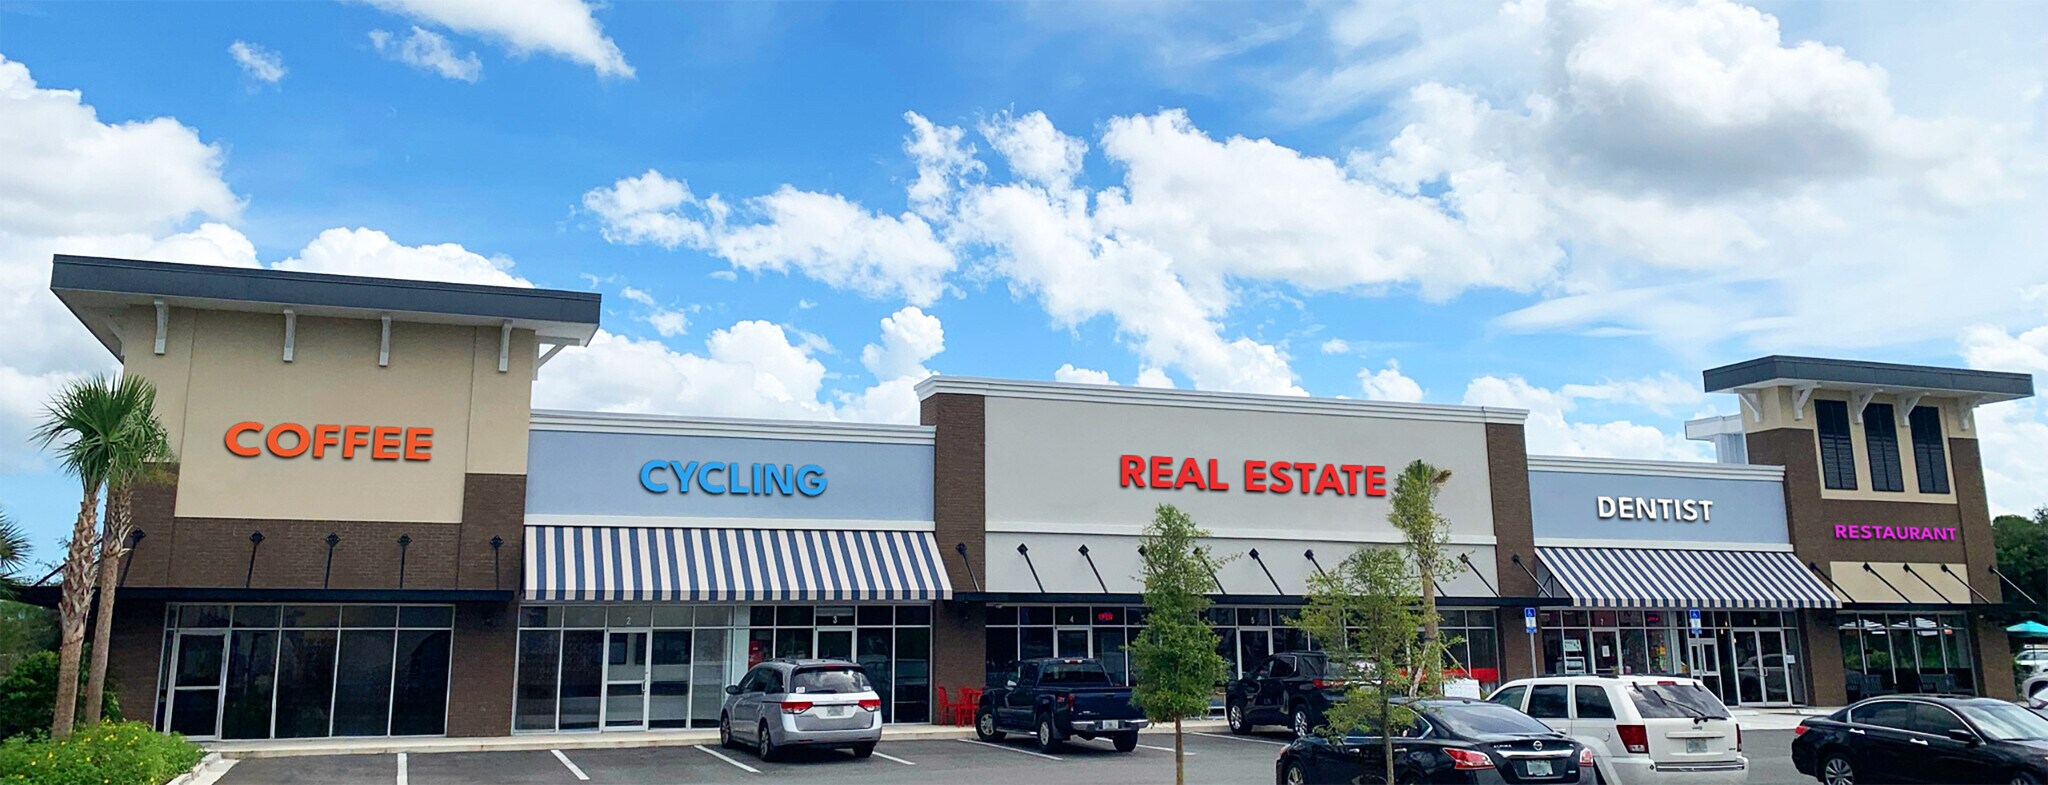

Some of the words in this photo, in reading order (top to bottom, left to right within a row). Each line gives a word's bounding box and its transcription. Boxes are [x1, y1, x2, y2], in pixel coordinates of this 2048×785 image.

[225, 421, 434, 461] COFFEE
[639, 459, 828, 497] CYCLING
[1120, 454, 1230, 491] REAL
[1244, 459, 1387, 497] ESTATE
[1597, 496, 1714, 521] DENTIST
[1834, 524, 1957, 541] RESTAURANT
[626, 616, 632, 625] 2
[832, 615, 838, 624] 3
